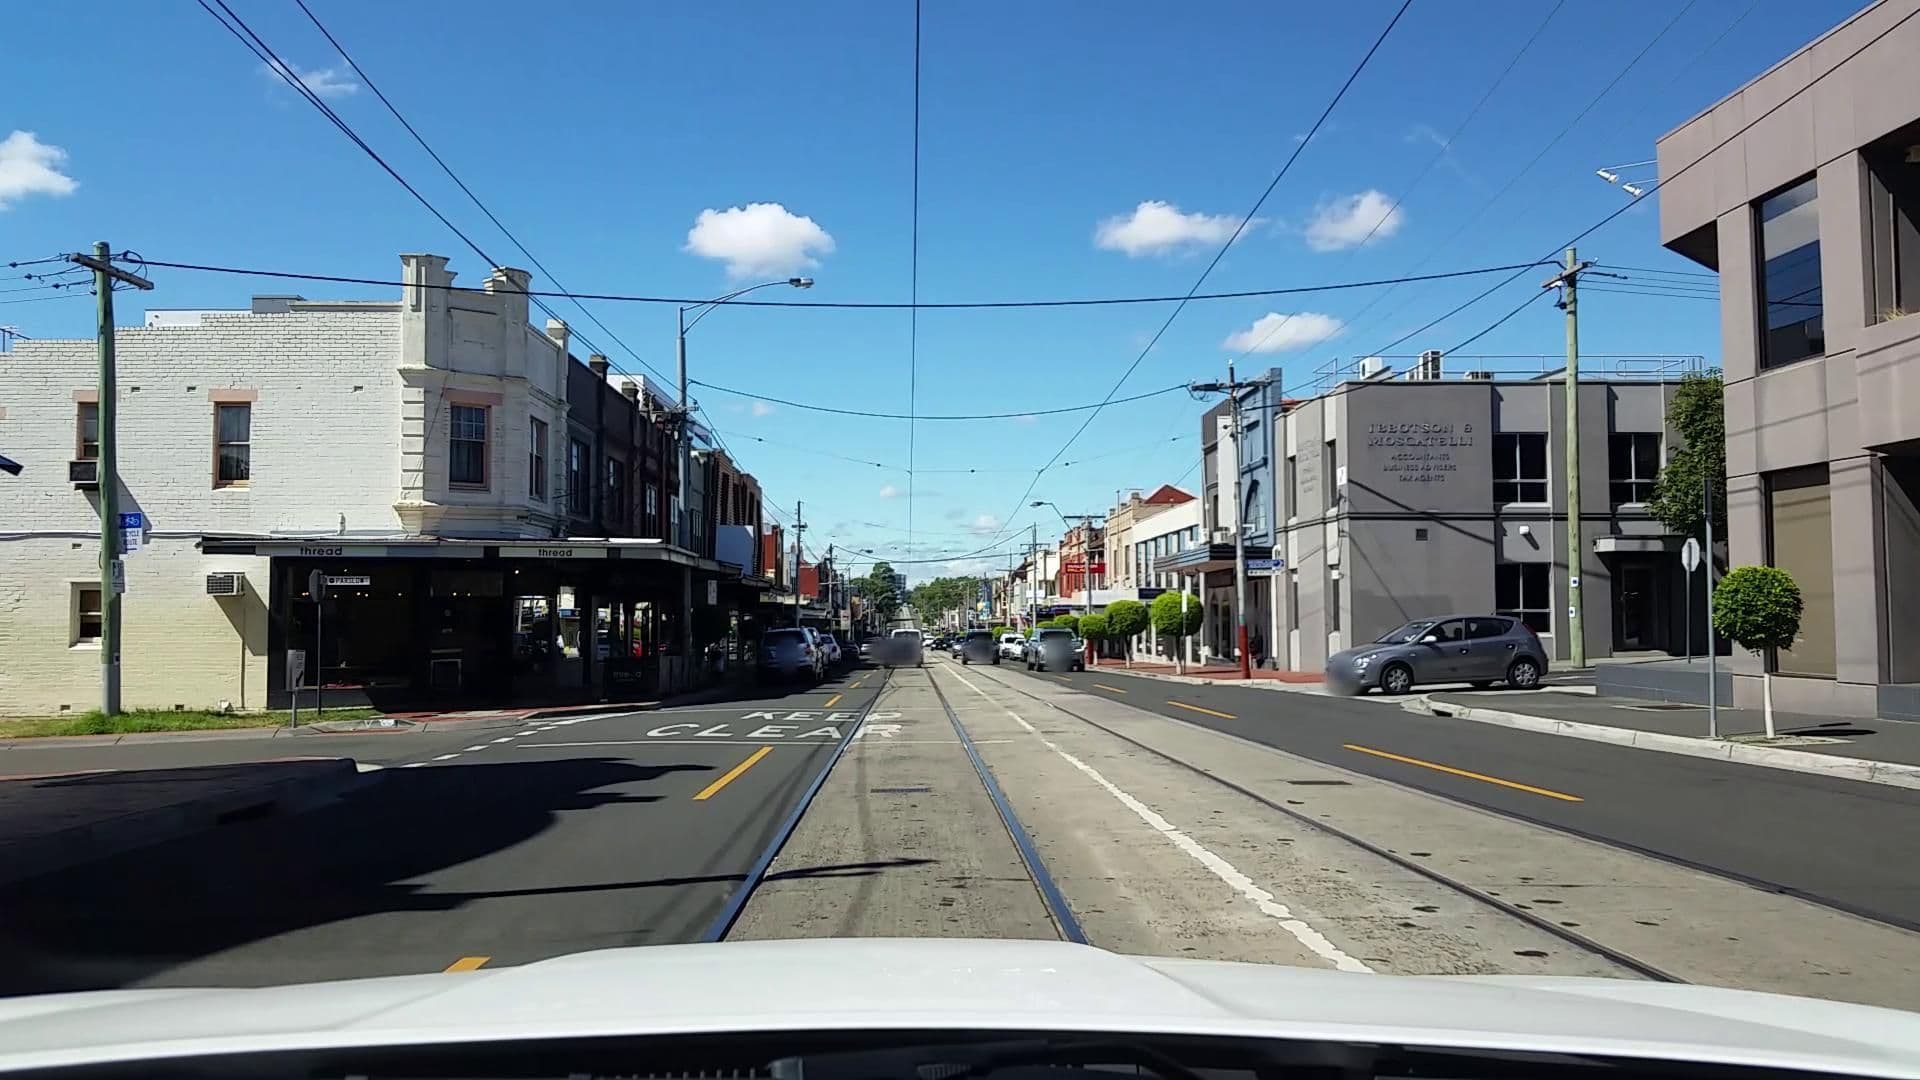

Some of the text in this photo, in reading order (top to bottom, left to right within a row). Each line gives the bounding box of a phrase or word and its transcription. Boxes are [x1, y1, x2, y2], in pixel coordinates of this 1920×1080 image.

[1367, 423, 1455, 434] IBBOTSON
[1367, 436, 1473, 447] MOSCATELLI
[300, 545, 343, 556] thread
[538, 548, 573, 557] thread
[646, 723, 903, 739] CLEAR
